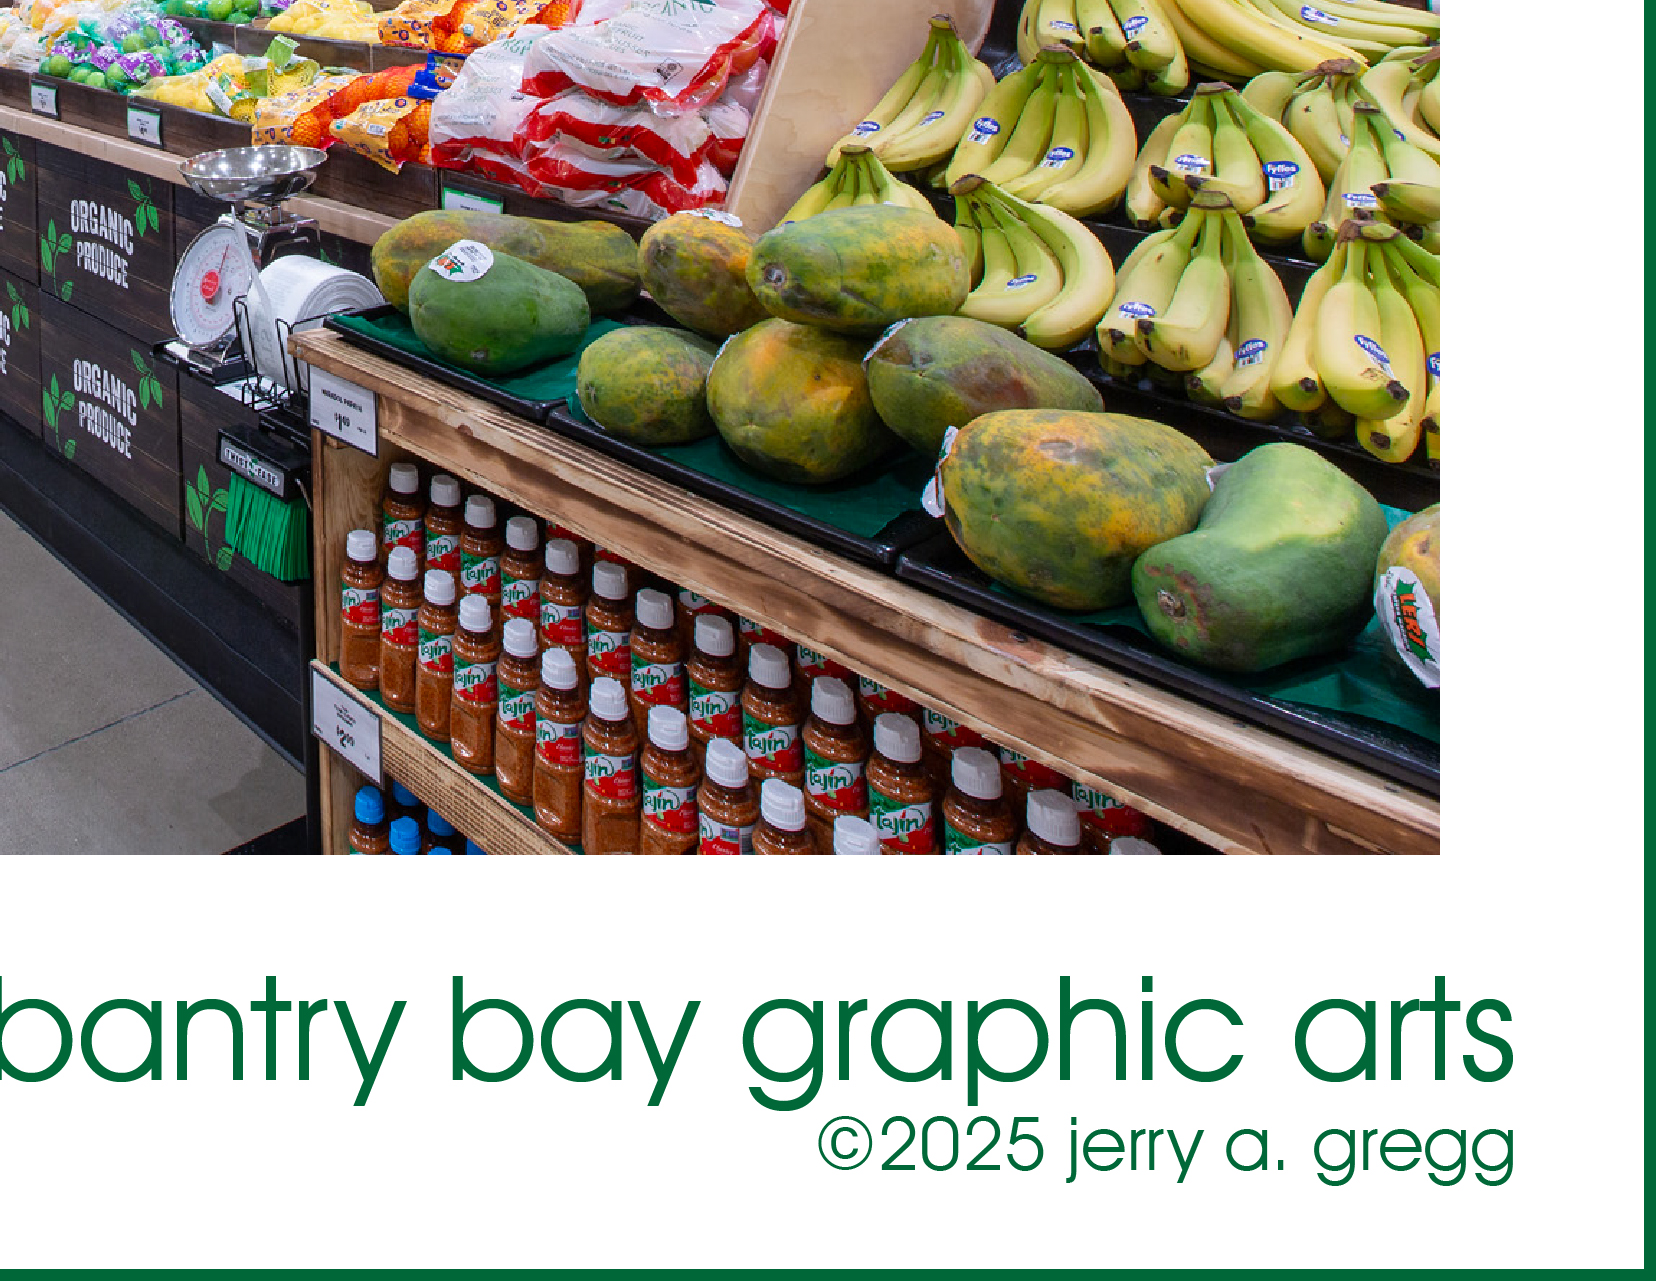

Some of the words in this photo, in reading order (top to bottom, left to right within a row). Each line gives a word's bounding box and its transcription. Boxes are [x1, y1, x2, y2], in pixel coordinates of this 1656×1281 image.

[70, 199, 134, 256] ORGANIC
[76, 241, 129, 290] PRODUCE
[73, 359, 138, 428] ORGANIC
[78, 401, 133, 461] PRODUCE
